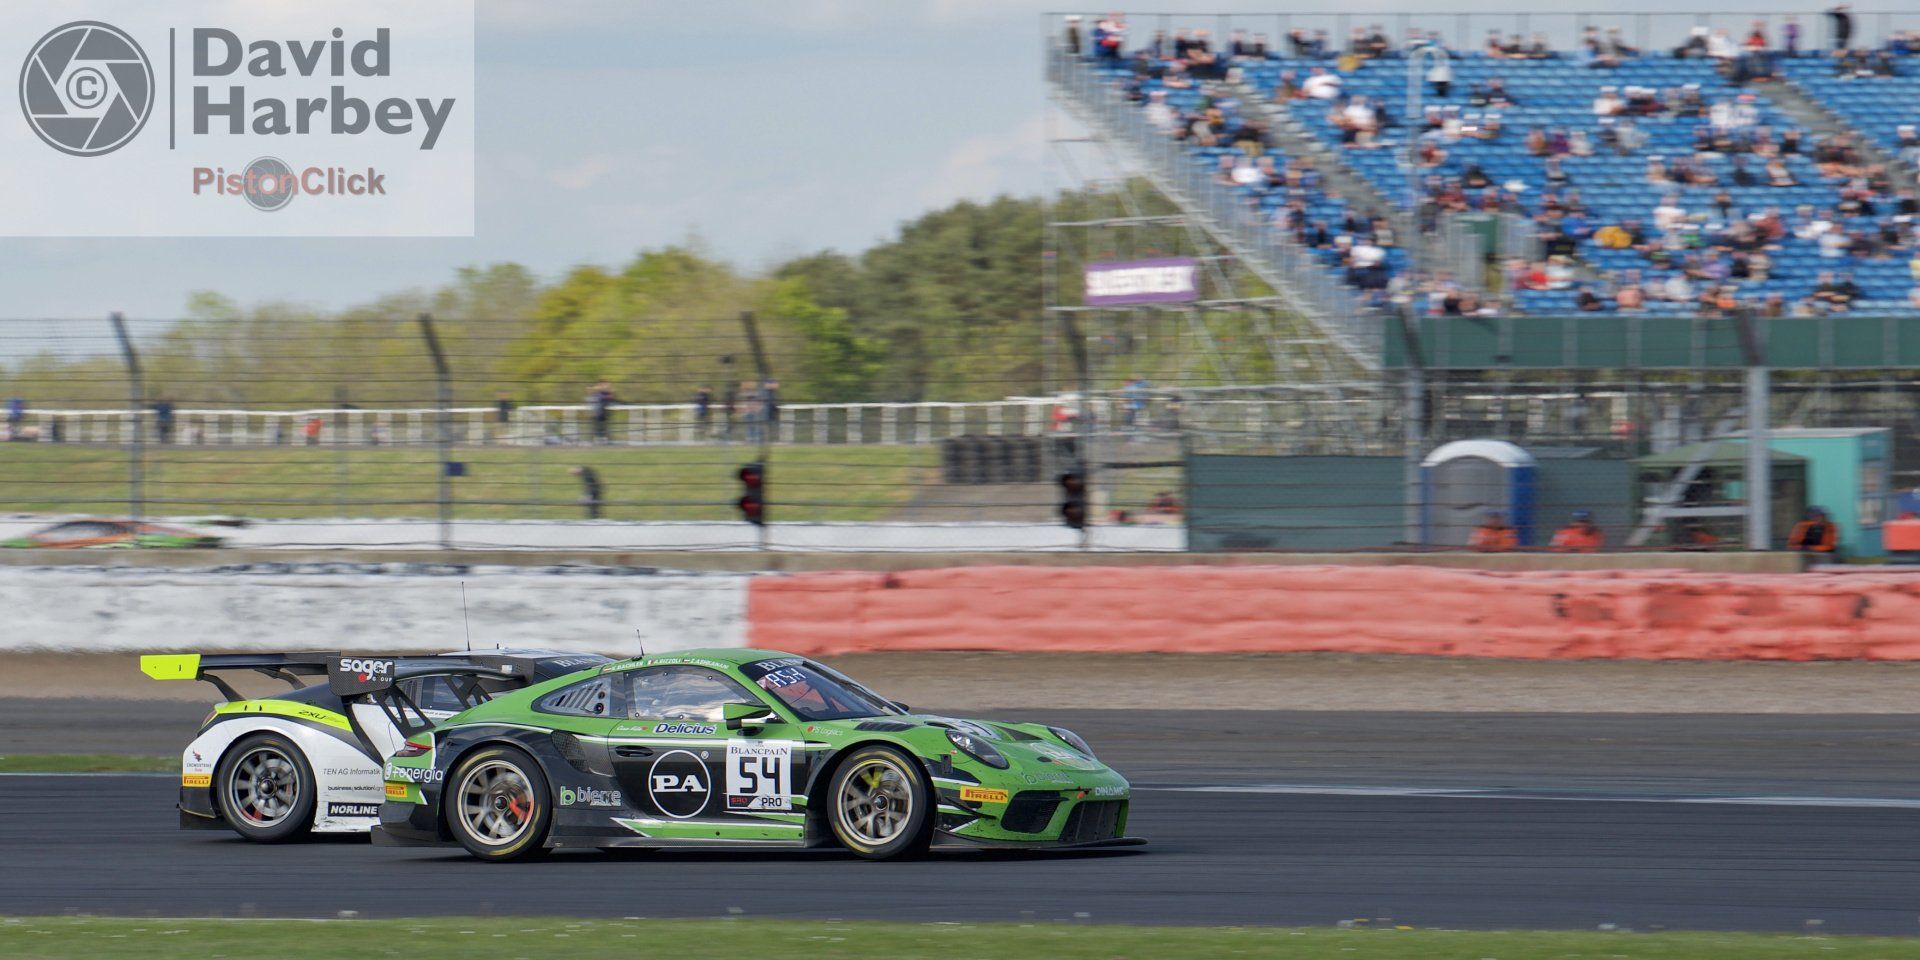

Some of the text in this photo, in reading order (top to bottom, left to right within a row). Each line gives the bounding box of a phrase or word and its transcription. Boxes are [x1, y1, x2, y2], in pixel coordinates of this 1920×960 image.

[655, 723, 716, 735] Delicius
[731, 746, 788, 755] BLANCPAIN
[323, 768, 381, 776] TEN AG Informatik
[739, 757, 780, 794] 54
[652, 775, 707, 793] PA
[965, 789, 1007, 801] PIRELLI
[761, 797, 782, 807] PRO
[330, 805, 378, 815] NORLINE
